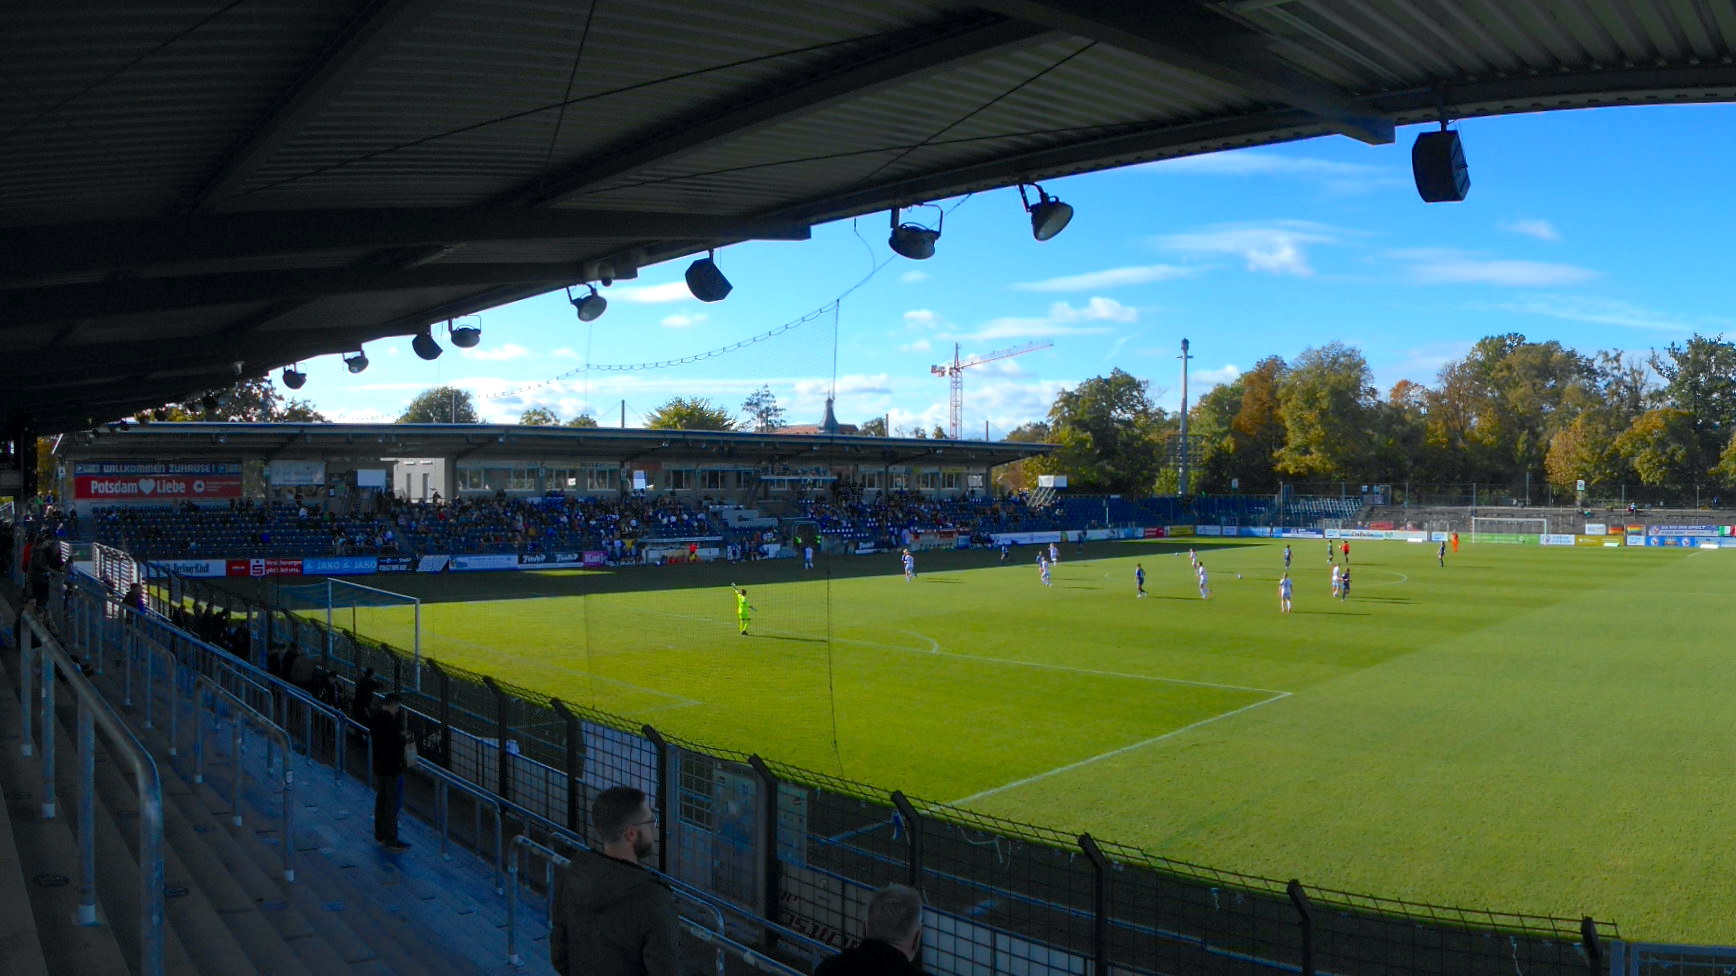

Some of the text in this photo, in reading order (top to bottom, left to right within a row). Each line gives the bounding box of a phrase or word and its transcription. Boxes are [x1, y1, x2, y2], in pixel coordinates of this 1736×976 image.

[90, 480, 186, 494] Potsdam Liebe
[316, 561, 340, 570] JAKO
